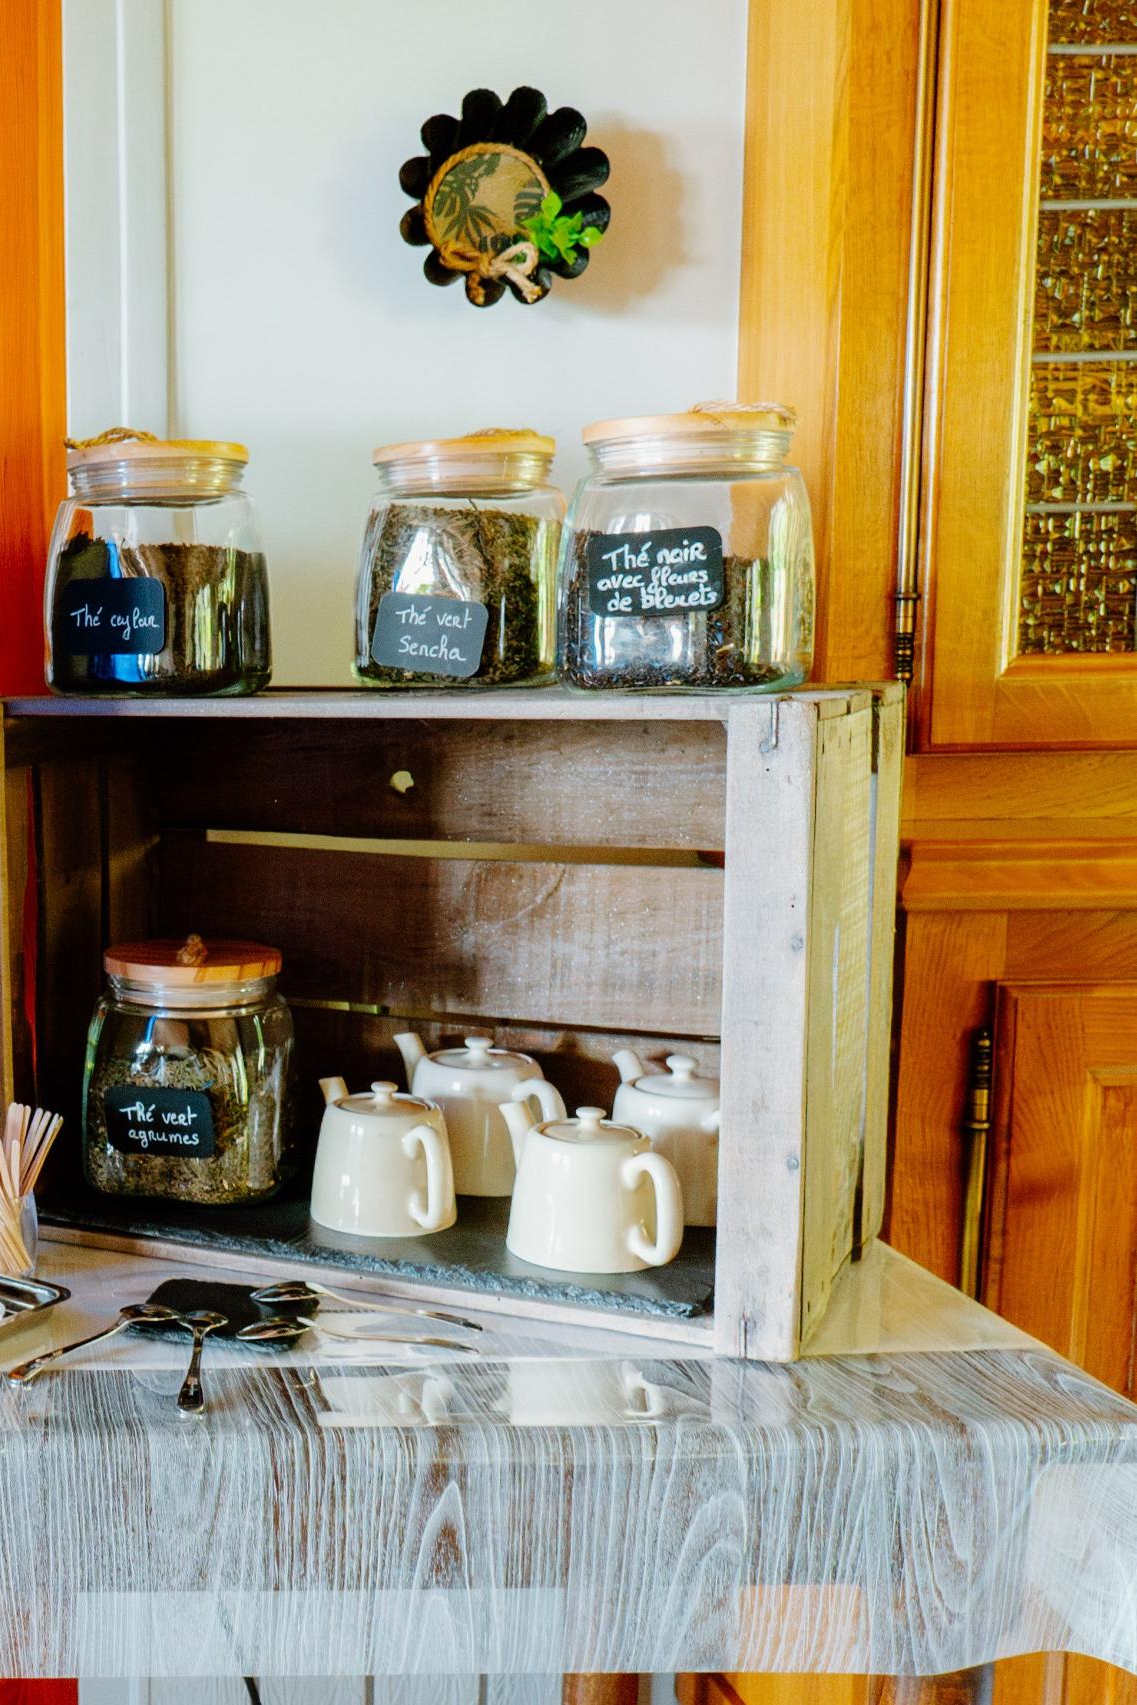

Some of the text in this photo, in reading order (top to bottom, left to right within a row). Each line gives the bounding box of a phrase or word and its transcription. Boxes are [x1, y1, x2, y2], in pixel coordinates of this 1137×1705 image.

[602, 541, 652, 571] Thé
[597, 565, 709, 594] avec fleurs
[607, 591, 632, 612] de
[70, 603, 103, 627] Thé
[395, 604, 472, 629] Thé vert
[398, 635, 467, 661] Sencha
[119, 1101, 197, 1126] Thé vert
[128, 1128, 200, 1148] agrumes
